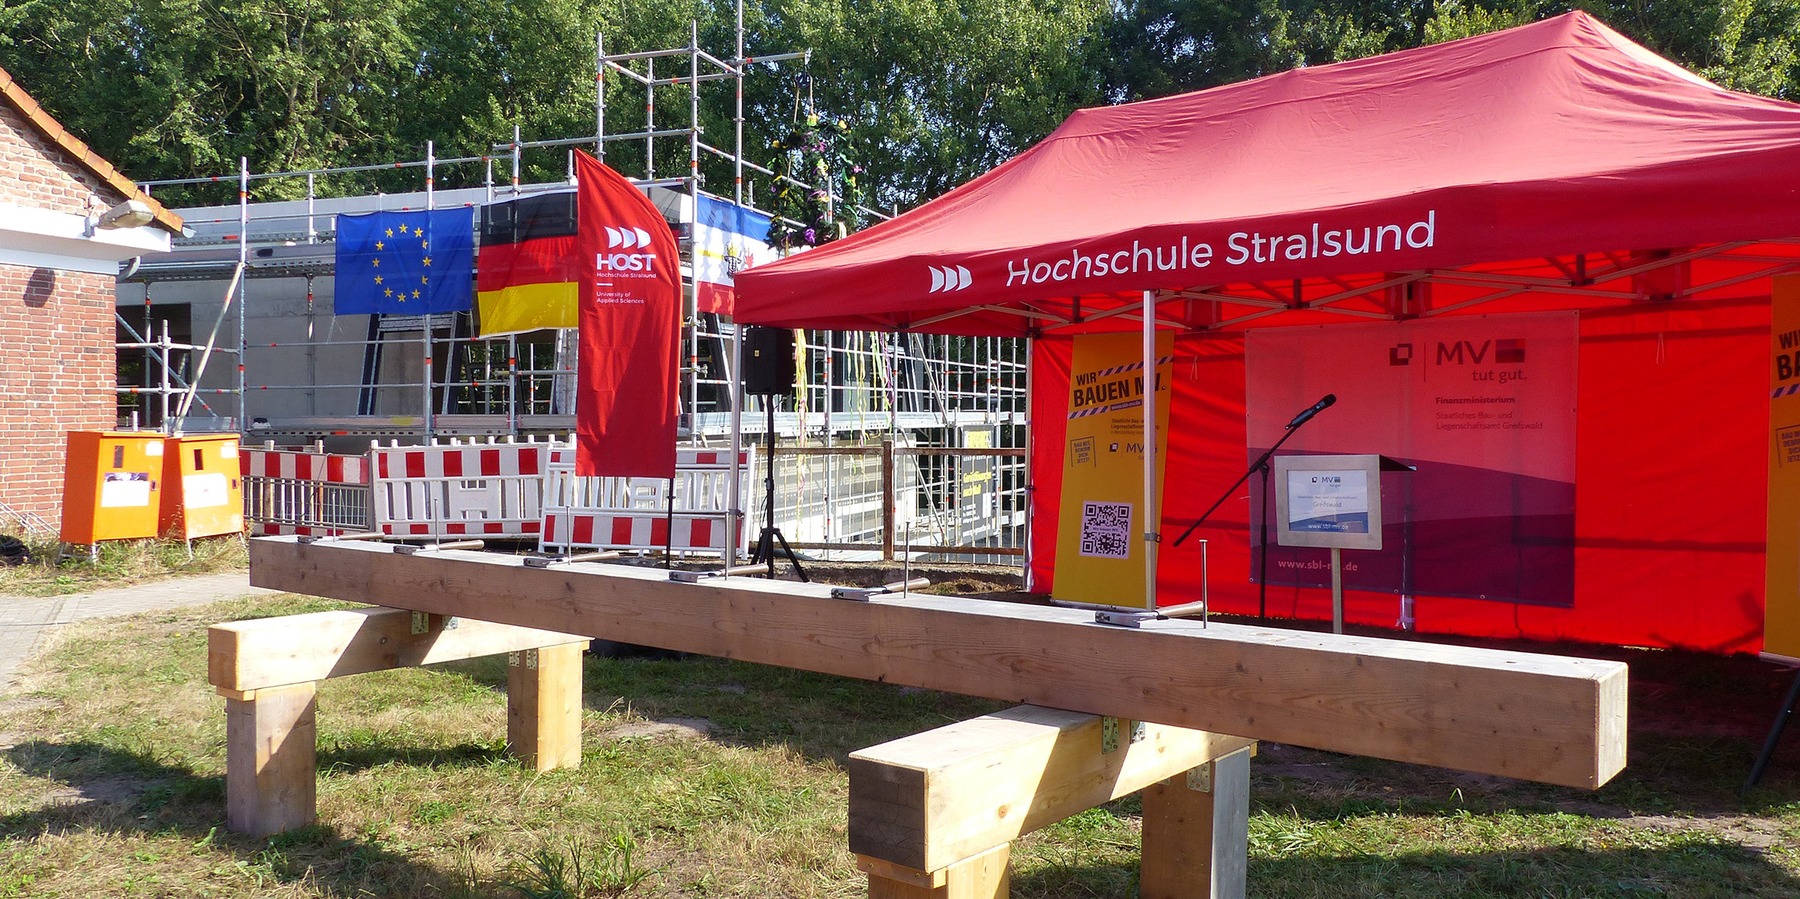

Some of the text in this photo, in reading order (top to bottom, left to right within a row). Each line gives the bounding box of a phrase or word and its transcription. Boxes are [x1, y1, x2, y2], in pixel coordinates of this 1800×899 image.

[1006, 210, 1436, 286] Hochschule Stralsund
[596, 253, 656, 271] HOST
[1778, 329, 1800, 350] WI
[1436, 339, 1491, 366] MV
[1076, 371, 1097, 386] WIR
[1472, 368, 1528, 384] tut gut.
[1073, 379, 1130, 407] BAUEN
[1435, 396, 1515, 405] Finanzministerium
[1436, 410, 1476, 420] Staatliches
[1497, 410, 1513, 420] und
[1436, 421, 1543, 432] Liegenschaftsamt Greifswald
[1278, 560, 1358, 571] www.sbl-m.de
